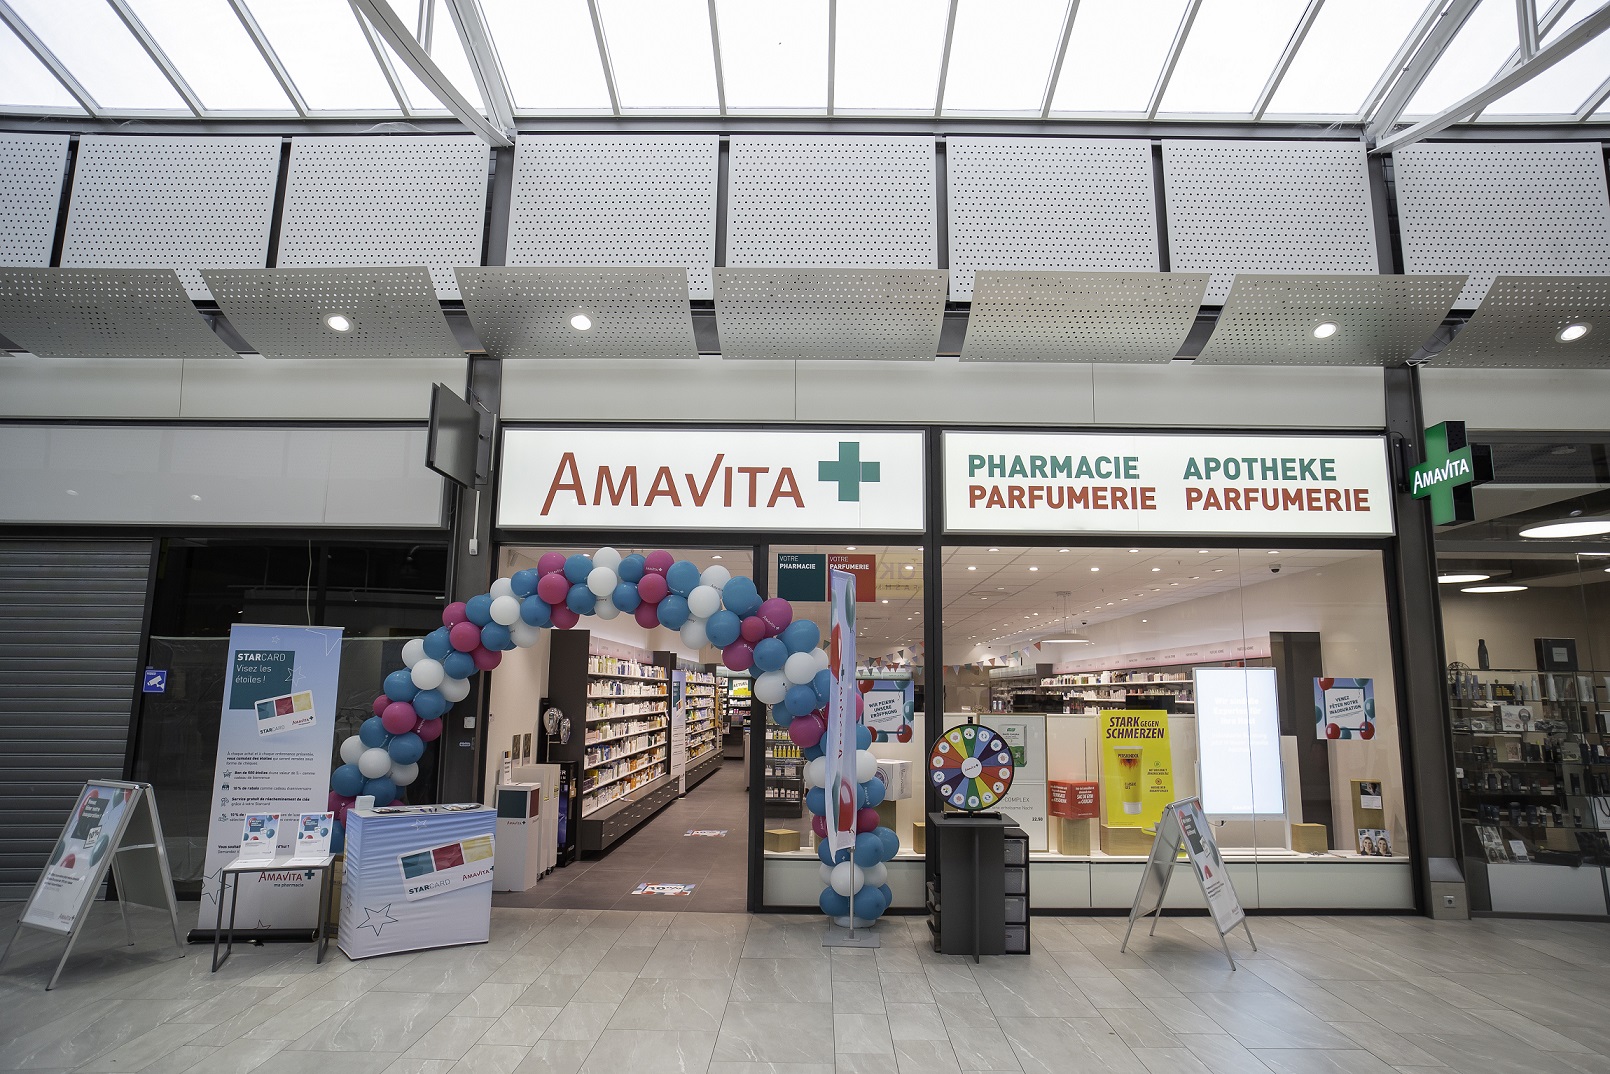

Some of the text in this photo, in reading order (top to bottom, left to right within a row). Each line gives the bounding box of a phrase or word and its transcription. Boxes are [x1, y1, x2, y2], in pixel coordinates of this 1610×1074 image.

[968, 454, 1139, 480] PHARMACIE
[1183, 457, 1337, 481] APOTHEKE
[969, 485, 1157, 510] PARFUMERIE
[1185, 487, 1371, 512] PARFUMERIE
[237, 653, 286, 661] STARCARD
[1110, 717, 1140, 727] STARK
[1106, 728, 1164, 738] SCHMERZEN
[409, 879, 451, 895] STARCARD
